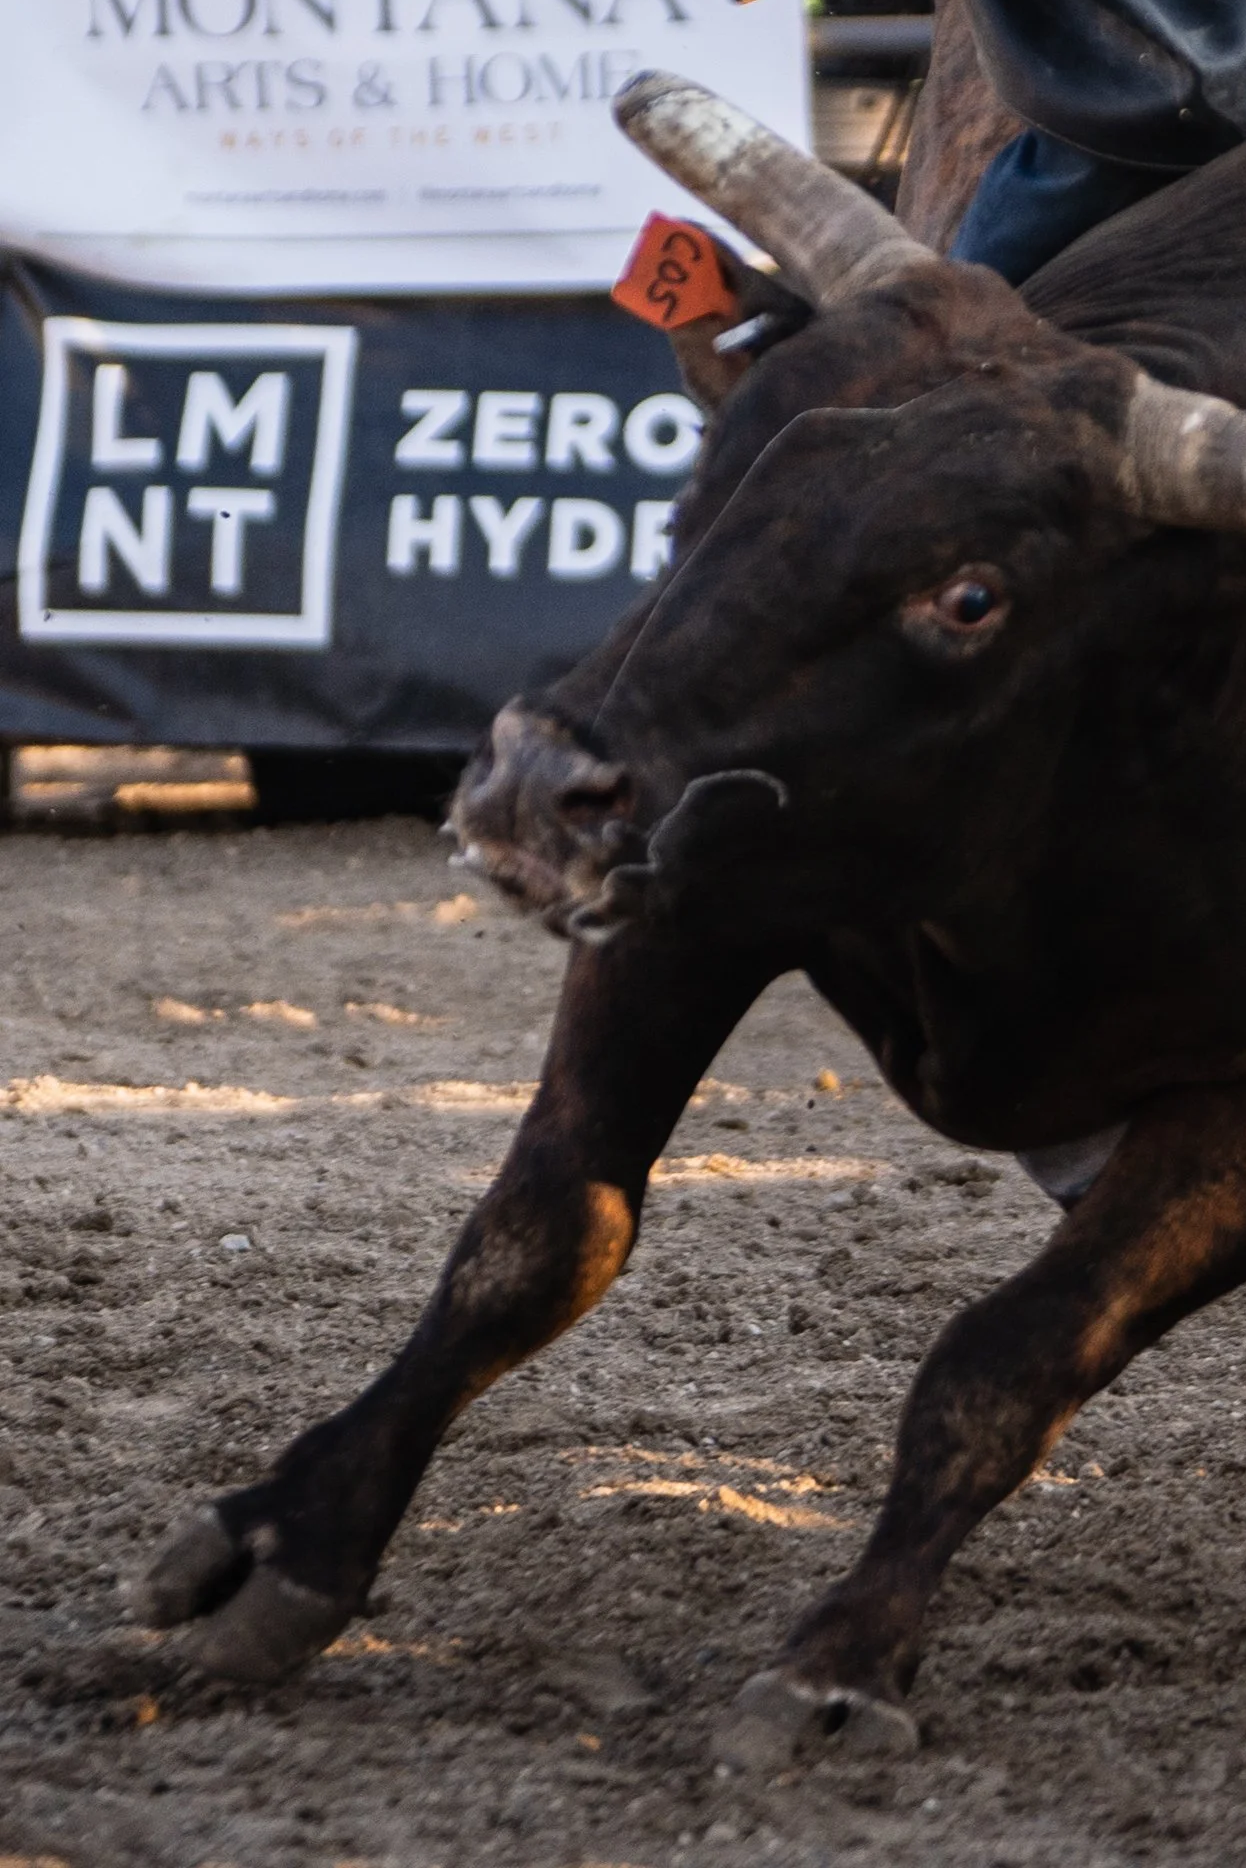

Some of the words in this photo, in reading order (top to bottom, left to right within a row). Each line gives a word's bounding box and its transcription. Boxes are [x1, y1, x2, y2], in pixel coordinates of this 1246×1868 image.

[142, 57, 328, 113] ARTS
[352, 58, 398, 110] &
[395, 389, 704, 472] ZERO
